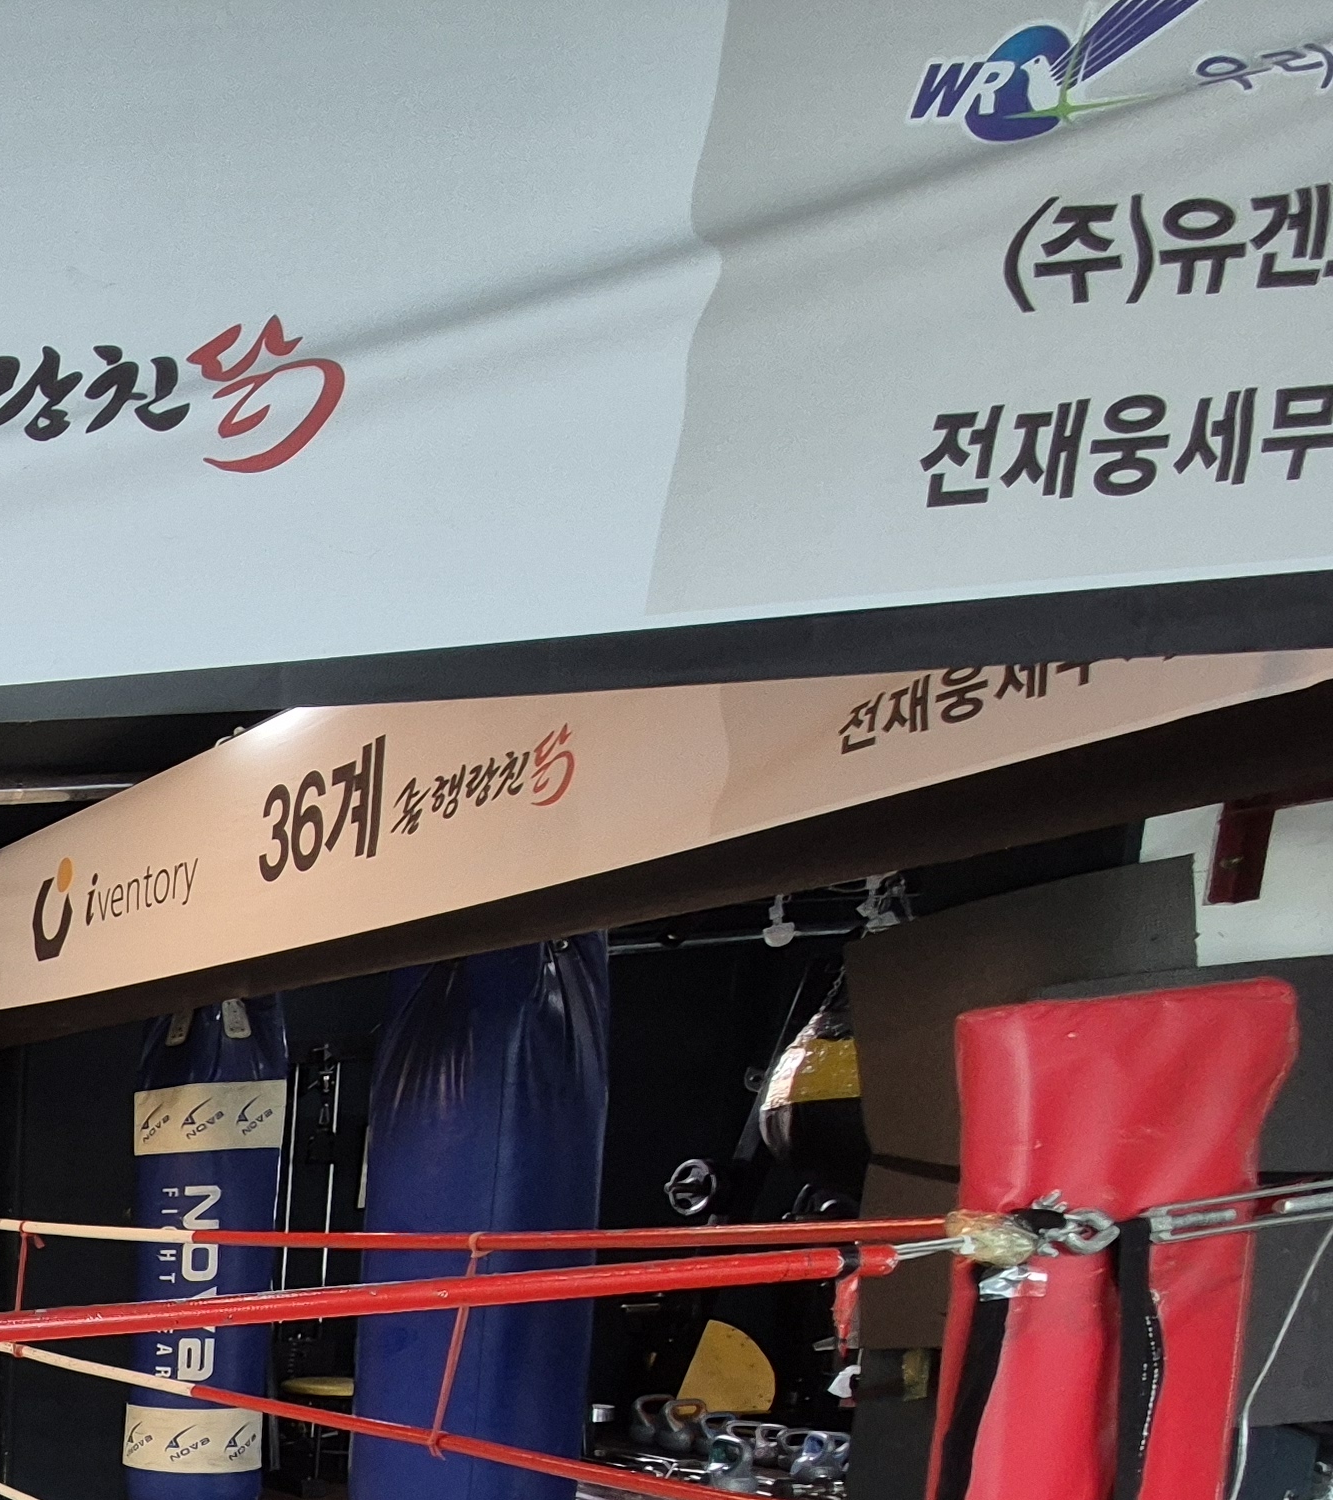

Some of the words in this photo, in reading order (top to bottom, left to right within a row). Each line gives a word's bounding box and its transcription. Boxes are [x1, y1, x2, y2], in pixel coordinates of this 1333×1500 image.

[1002, 181, 1333, 313] (주)유겐
[838, 659, 1101, 755] 전재웅세
[258, 734, 387, 883] 36계
[85, 857, 199, 927] iventory
[157, 1187, 180, 1284] FIHT
